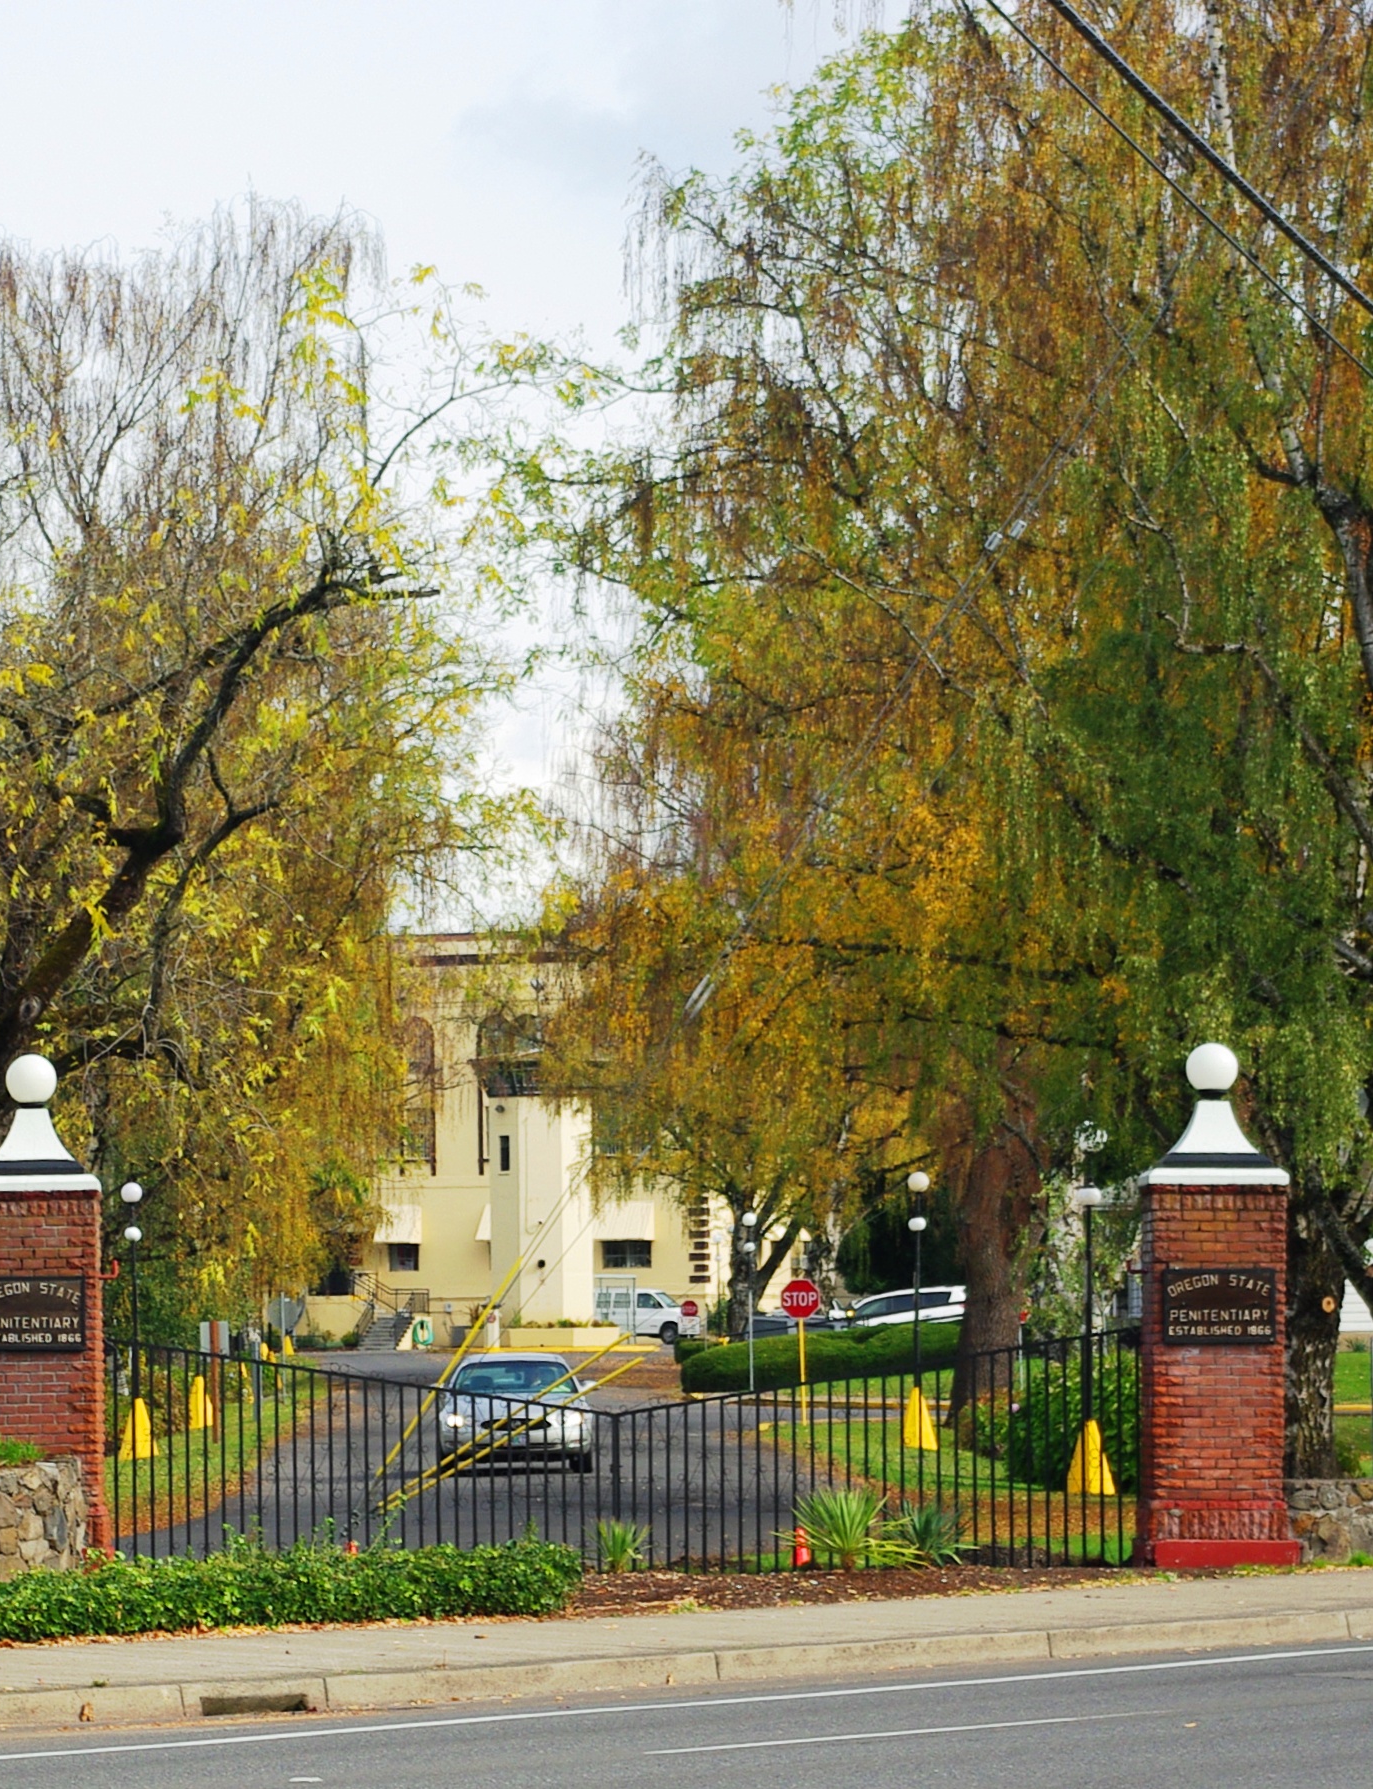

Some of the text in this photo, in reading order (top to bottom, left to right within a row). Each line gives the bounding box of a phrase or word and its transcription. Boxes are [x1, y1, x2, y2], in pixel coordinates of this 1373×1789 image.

[1167, 1274, 1271, 1297] OREGON STATE
[39, 1282, 81, 1304] STATE
[783, 1292, 817, 1306] STOP
[1169, 1309, 1269, 1322] PENITENTIARY
[1168, 1326, 1242, 1336] ESTABLISHED
[58, 1333, 81, 1343] 1866
